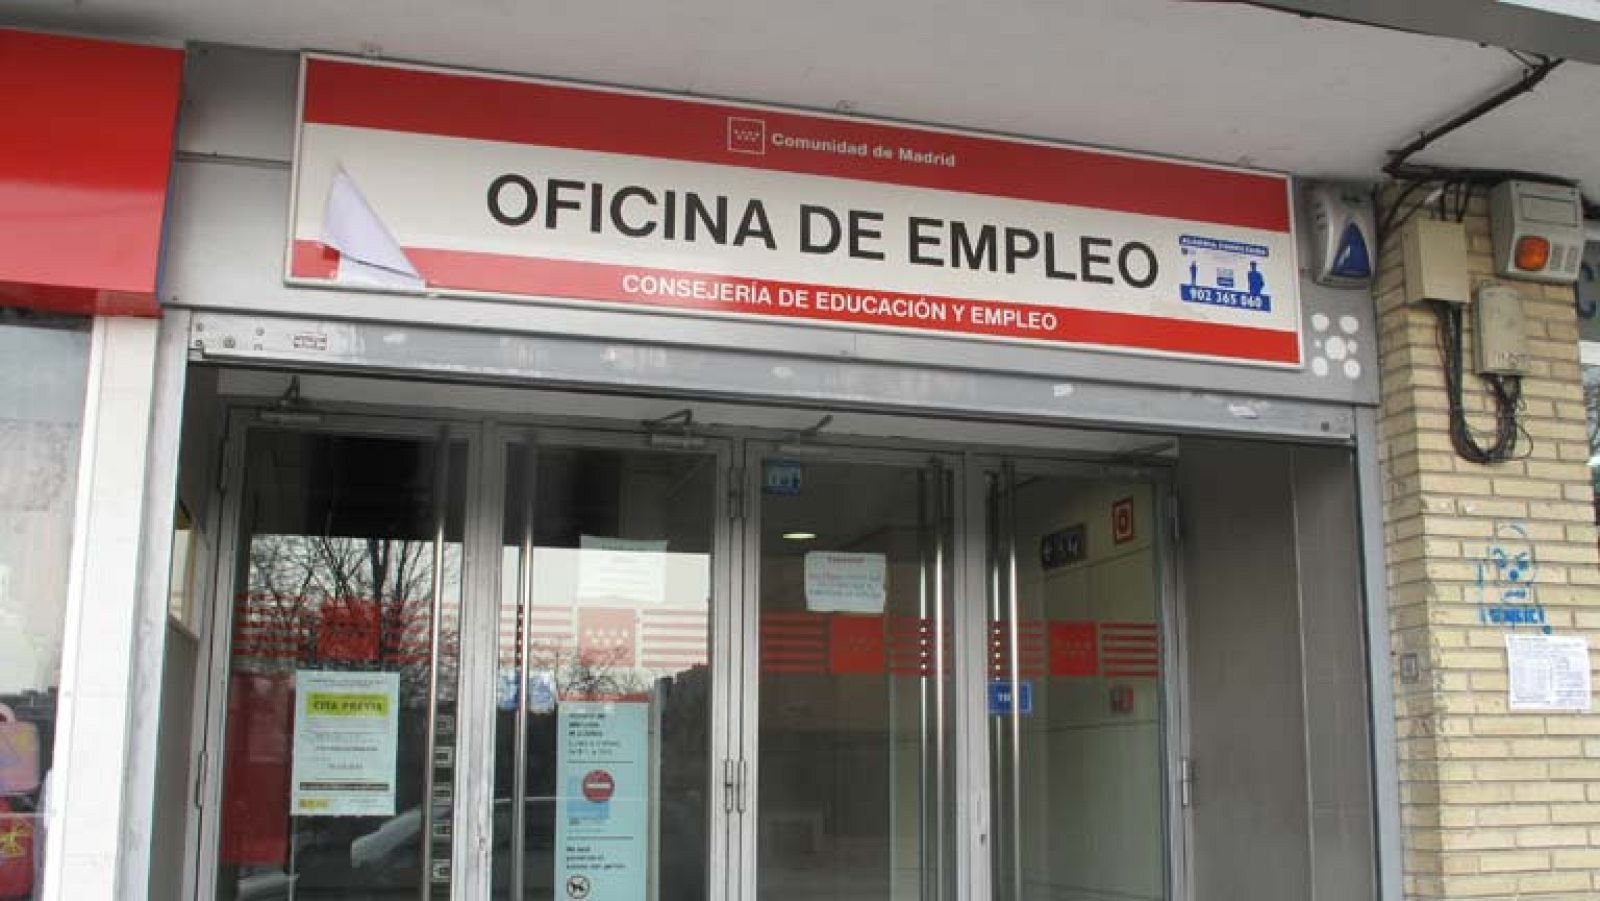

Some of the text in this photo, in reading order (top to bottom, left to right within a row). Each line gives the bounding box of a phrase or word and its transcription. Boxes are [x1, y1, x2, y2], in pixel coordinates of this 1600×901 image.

[772, 133, 955, 167] Comunidad de Madrid
[487, 173, 1158, 288] OFICINA DE EMPLEO
[622, 273, 1057, 331] CONSEJERÍA DE EDUCACIÓN Y EMPLEO
[1216, 291, 1237, 304] 365
